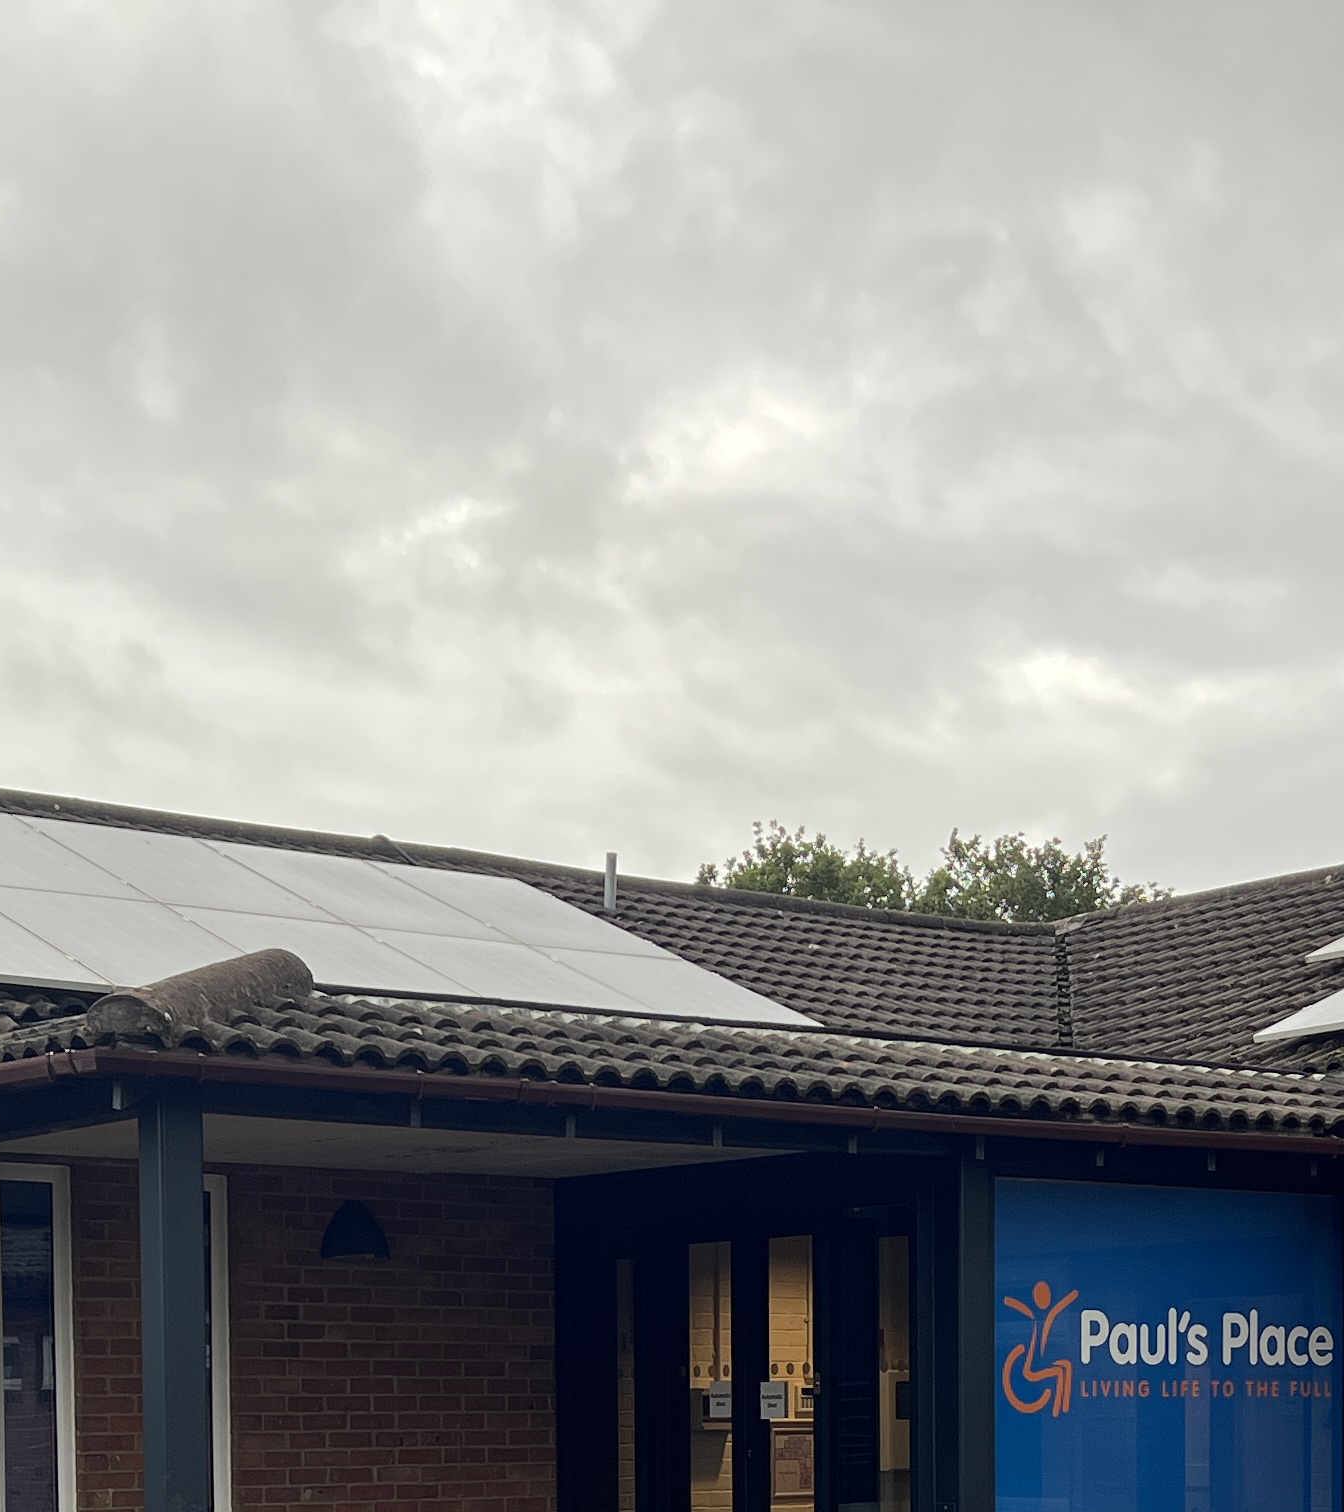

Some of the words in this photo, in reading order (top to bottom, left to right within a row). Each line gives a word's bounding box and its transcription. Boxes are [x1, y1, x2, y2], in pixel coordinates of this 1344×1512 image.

[1080, 1307, 1209, 1366] Paul's
[1222, 1308, 1334, 1366] Place
[1080, 1379, 1151, 1398] LIVING
[1161, 1379, 1200, 1398] LIFE
[1211, 1379, 1235, 1398] TO
[1245, 1379, 1280, 1397] THE
[1290, 1379, 1333, 1397] FULL
